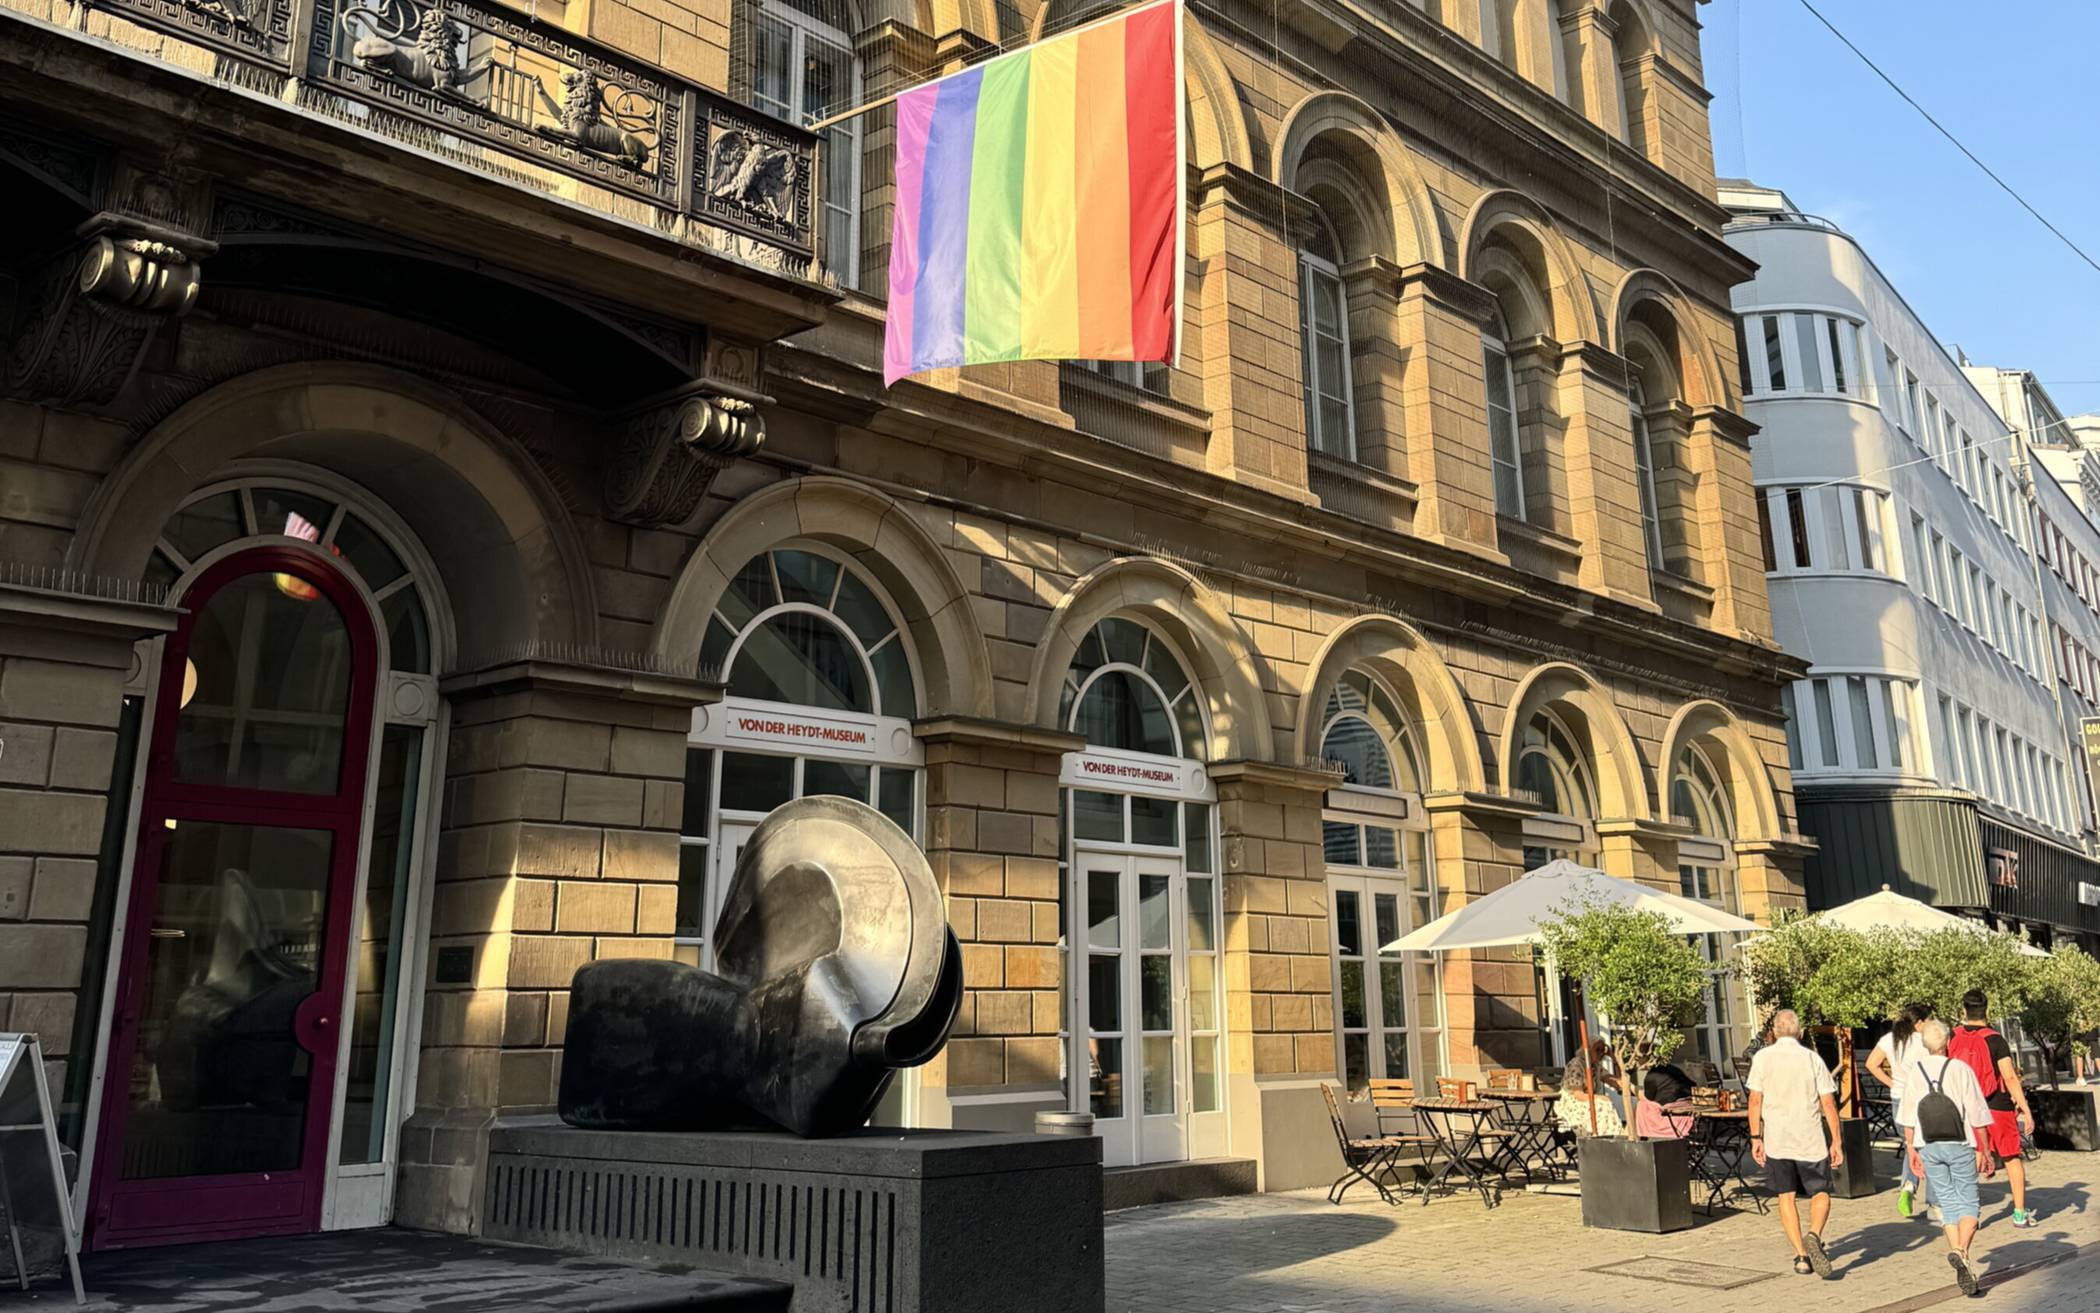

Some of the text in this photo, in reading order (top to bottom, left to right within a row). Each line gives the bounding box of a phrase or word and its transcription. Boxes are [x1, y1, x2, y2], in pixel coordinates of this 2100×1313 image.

[739, 718, 866, 744] VON DER HEYDT-MUSEUM
[1083, 761, 1174, 783] VON DER HEYDT-MUSEUM
